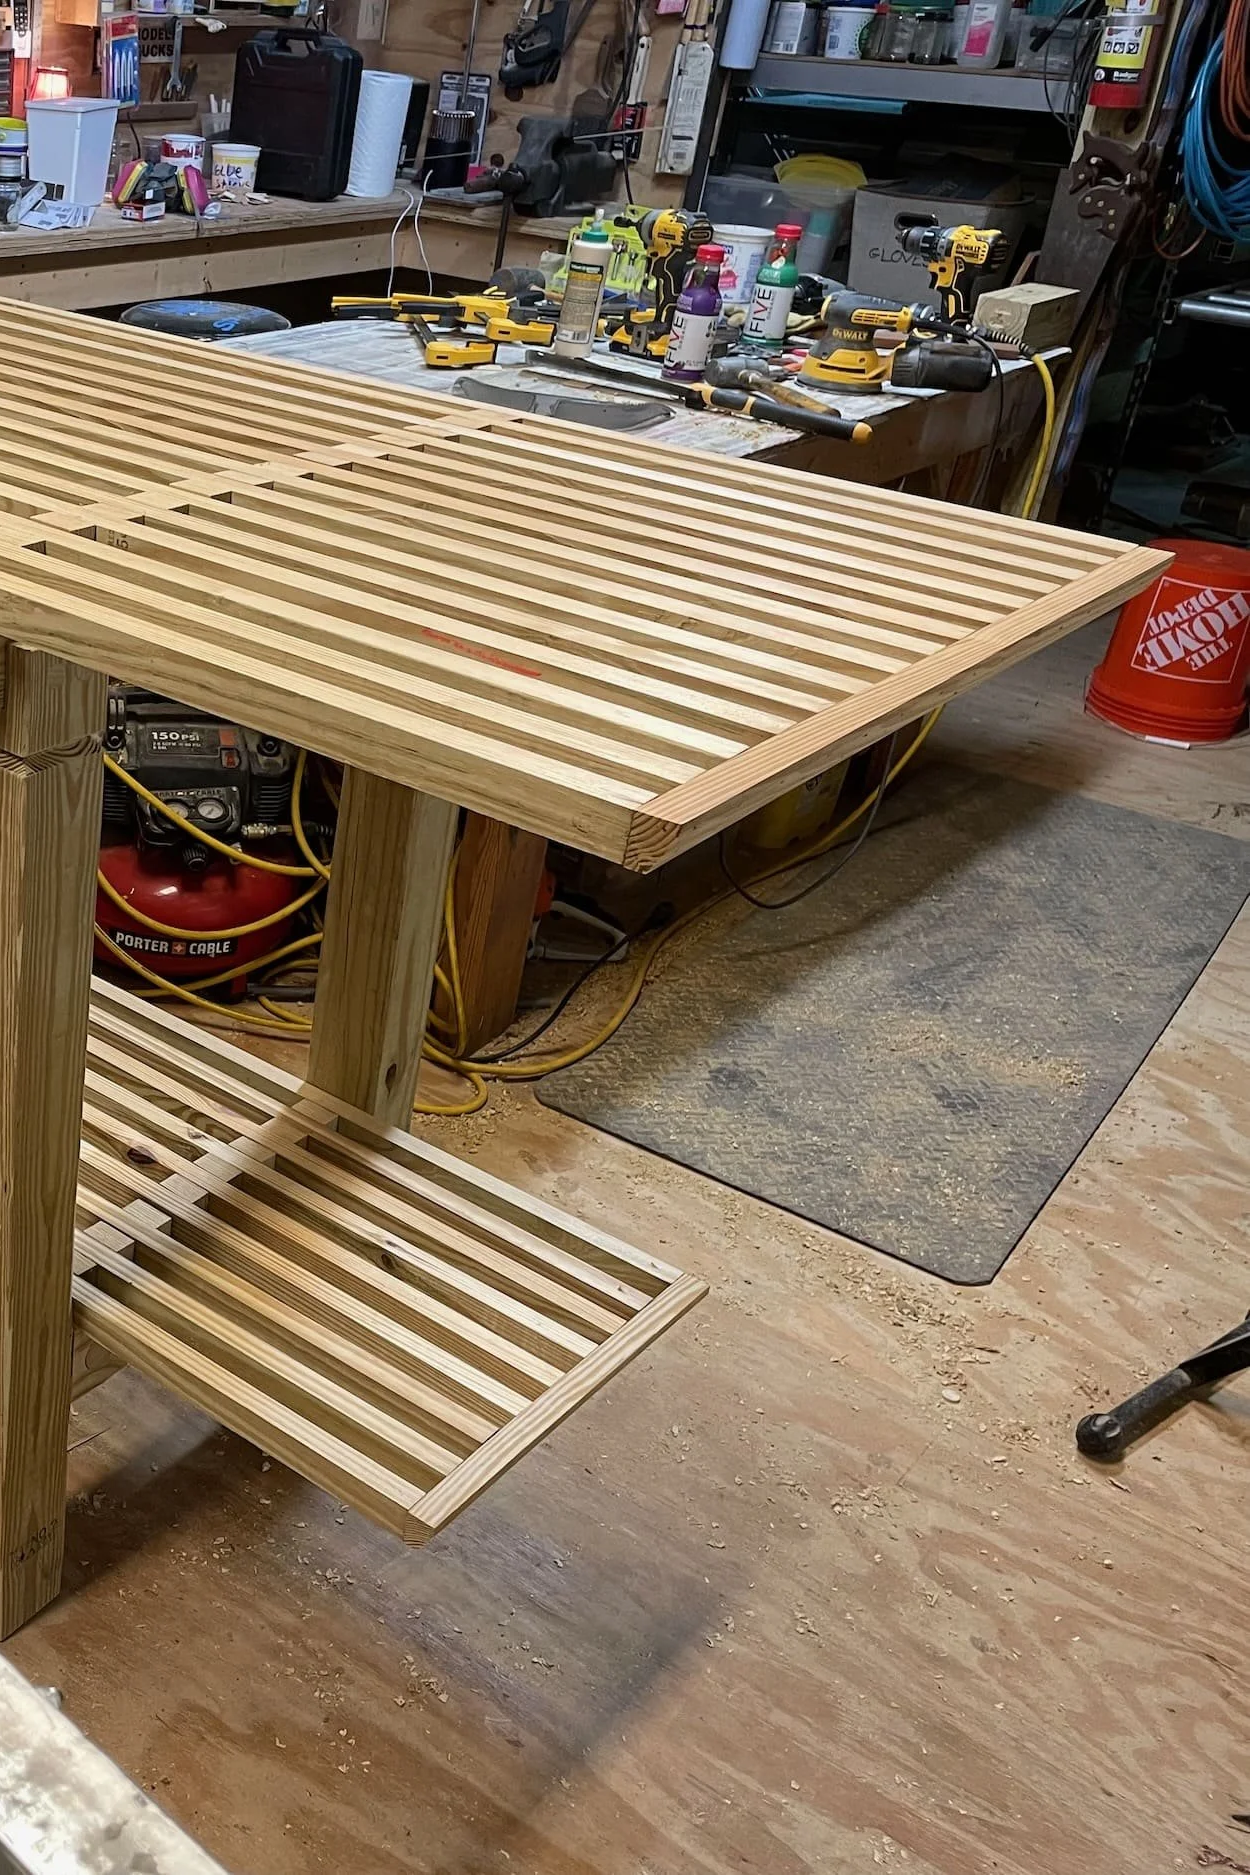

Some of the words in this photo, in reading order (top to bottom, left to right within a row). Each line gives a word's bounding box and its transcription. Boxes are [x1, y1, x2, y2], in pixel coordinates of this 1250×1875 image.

[138, 27, 175, 41] ODEL
[139, 44, 174, 57] UCKS
[869, 247, 928, 268] GLOVE
[750, 287, 773, 334] FIVE
[666, 316, 684, 364] FIVE
[1149, 588, 1220, 636] DEPOT
[1138, 592, 1250, 672] HOME
[152, 732, 180, 741] 150
[181, 733, 200, 741] PSI
[115, 932, 169, 953] PORTER
[189, 941, 230, 957] CABLE
